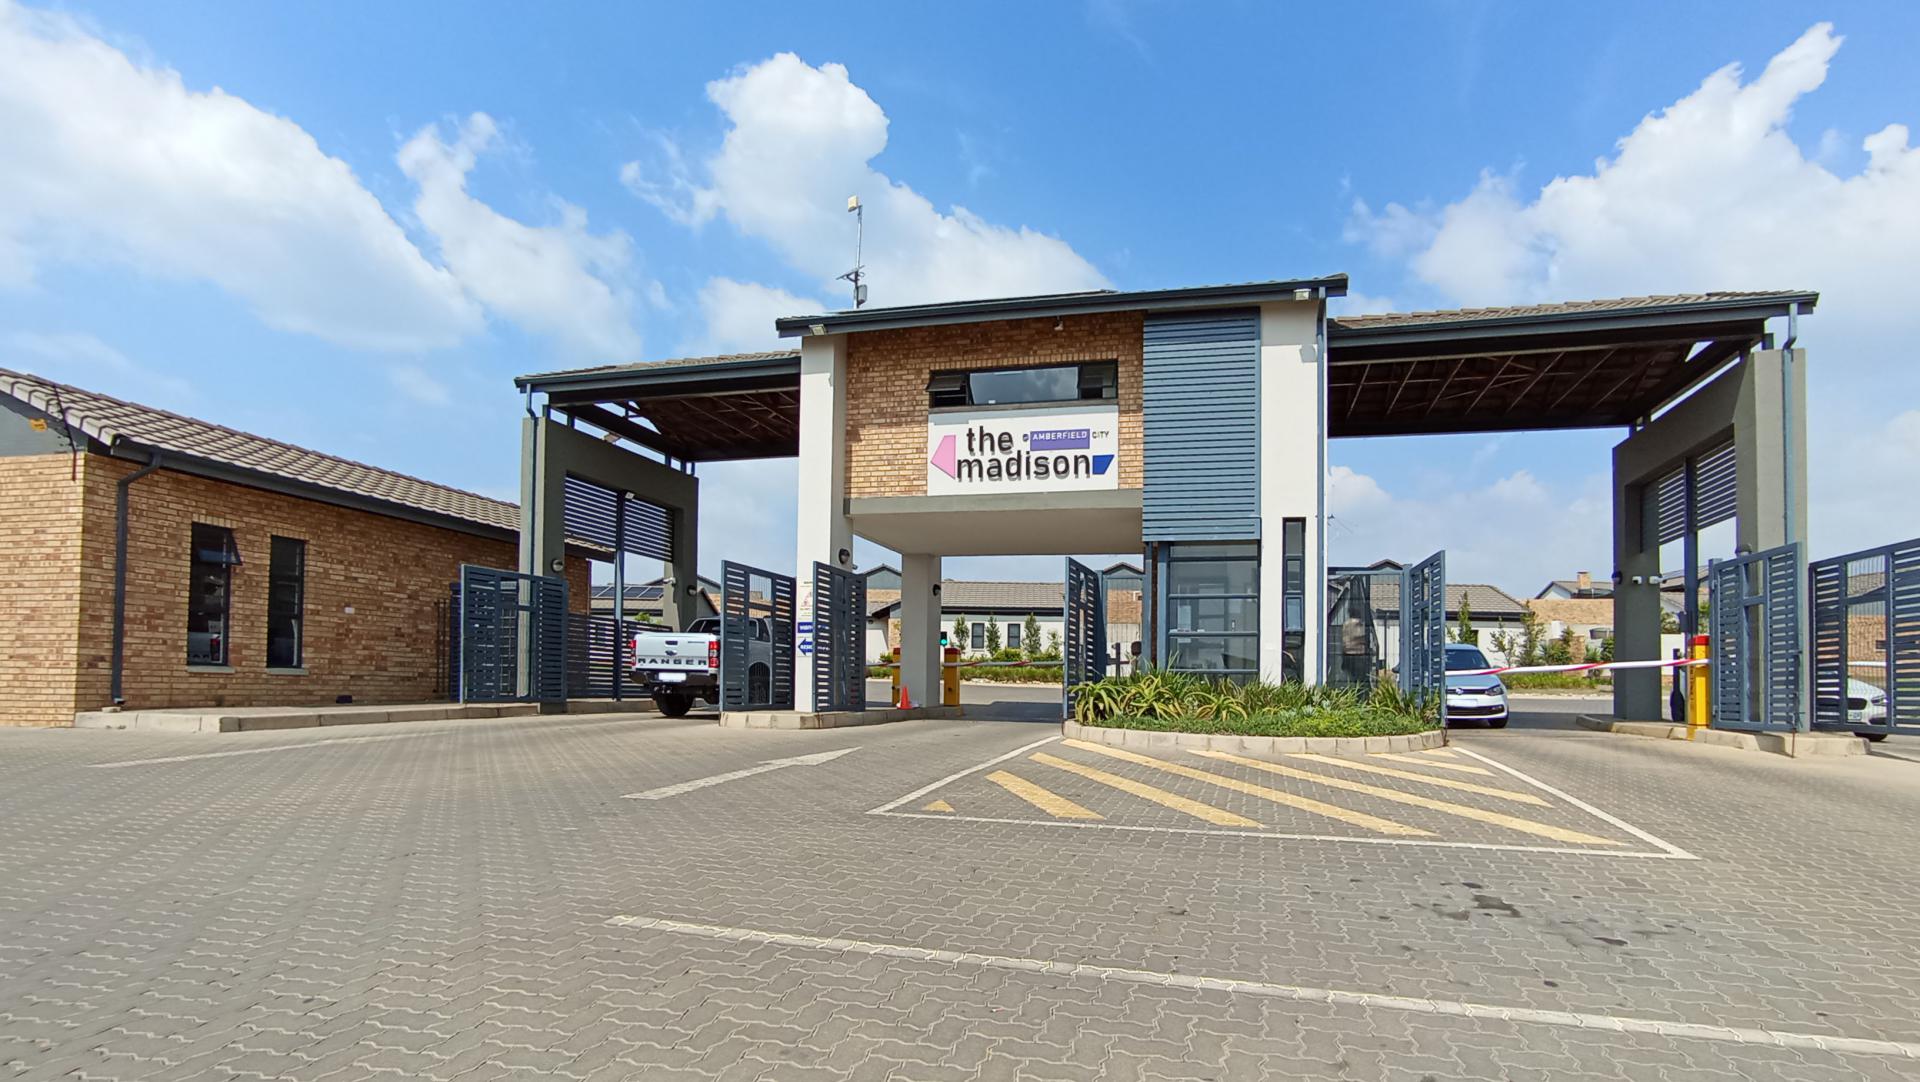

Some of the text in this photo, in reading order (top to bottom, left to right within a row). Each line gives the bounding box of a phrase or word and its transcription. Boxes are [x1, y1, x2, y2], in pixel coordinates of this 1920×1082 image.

[966, 425, 1013, 453] the
[1032, 431, 1109, 441] AMBERFIELD CITY
[957, 450, 1090, 479] madison
[637, 658, 707, 666] RANGER
